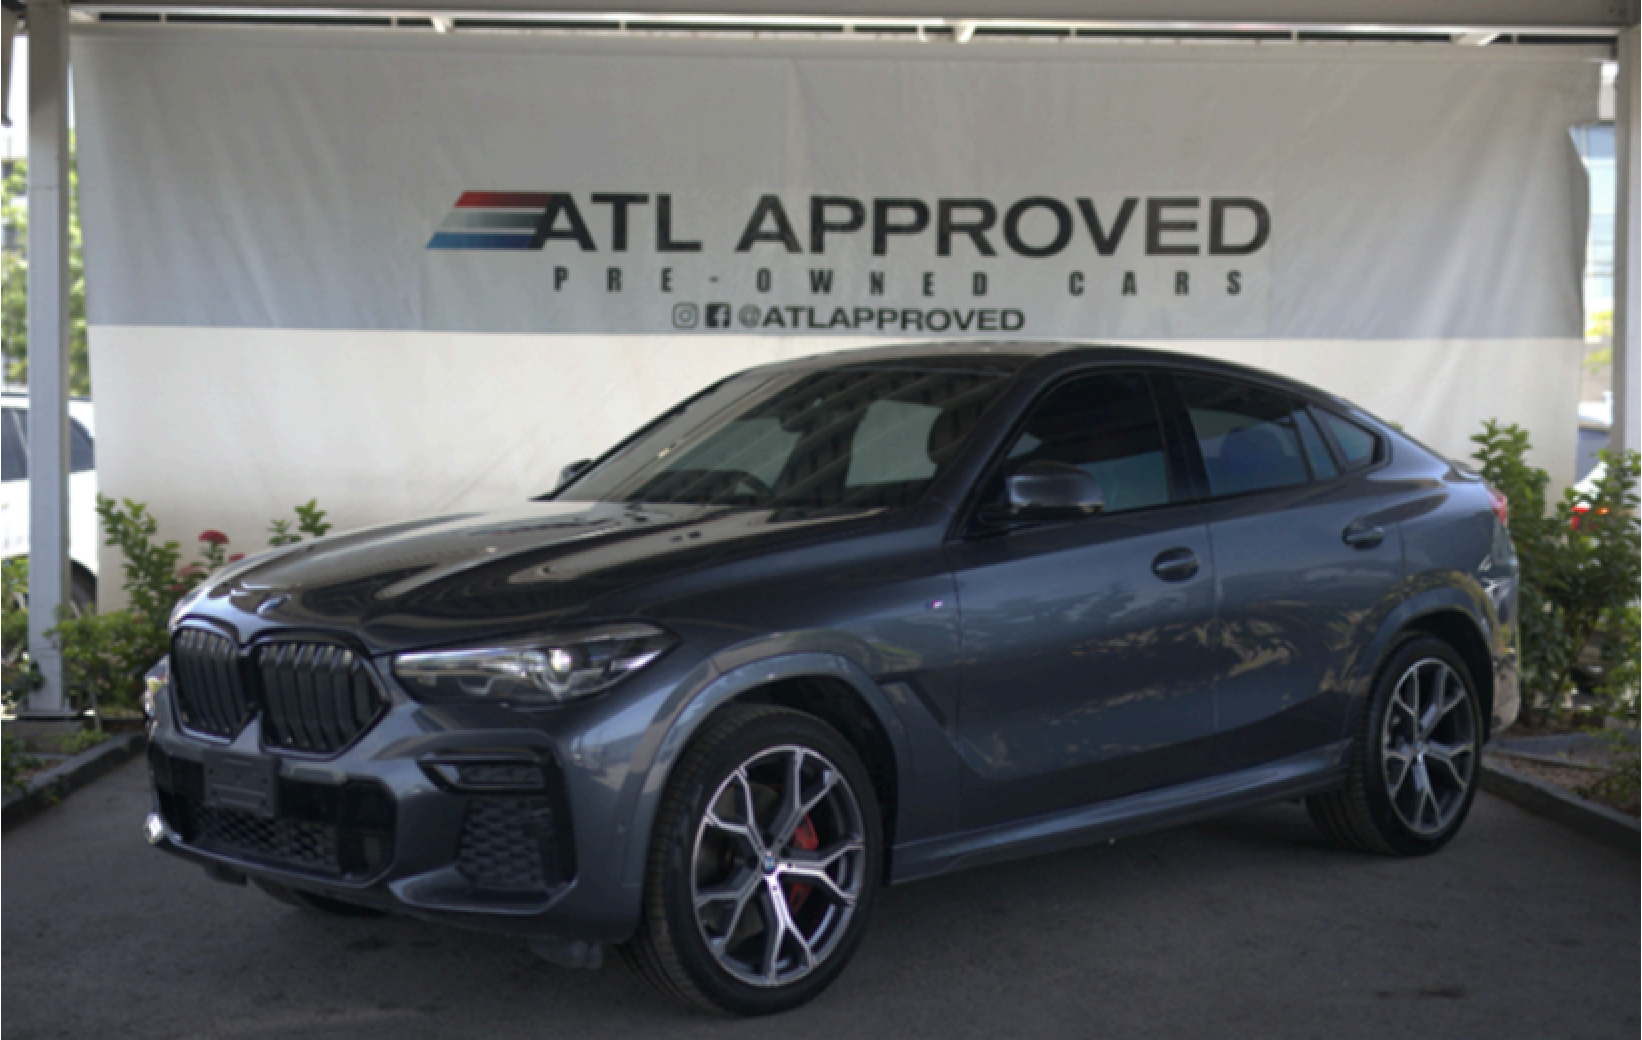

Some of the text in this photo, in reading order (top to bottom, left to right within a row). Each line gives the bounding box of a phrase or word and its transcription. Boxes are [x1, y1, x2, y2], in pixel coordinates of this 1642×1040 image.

[528, 192, 1272, 258] ATL APPROVED
[553, 266, 1243, 297] PRE-OWNED CARS
[738, 305, 1026, 332] @ATLAPPROVED
